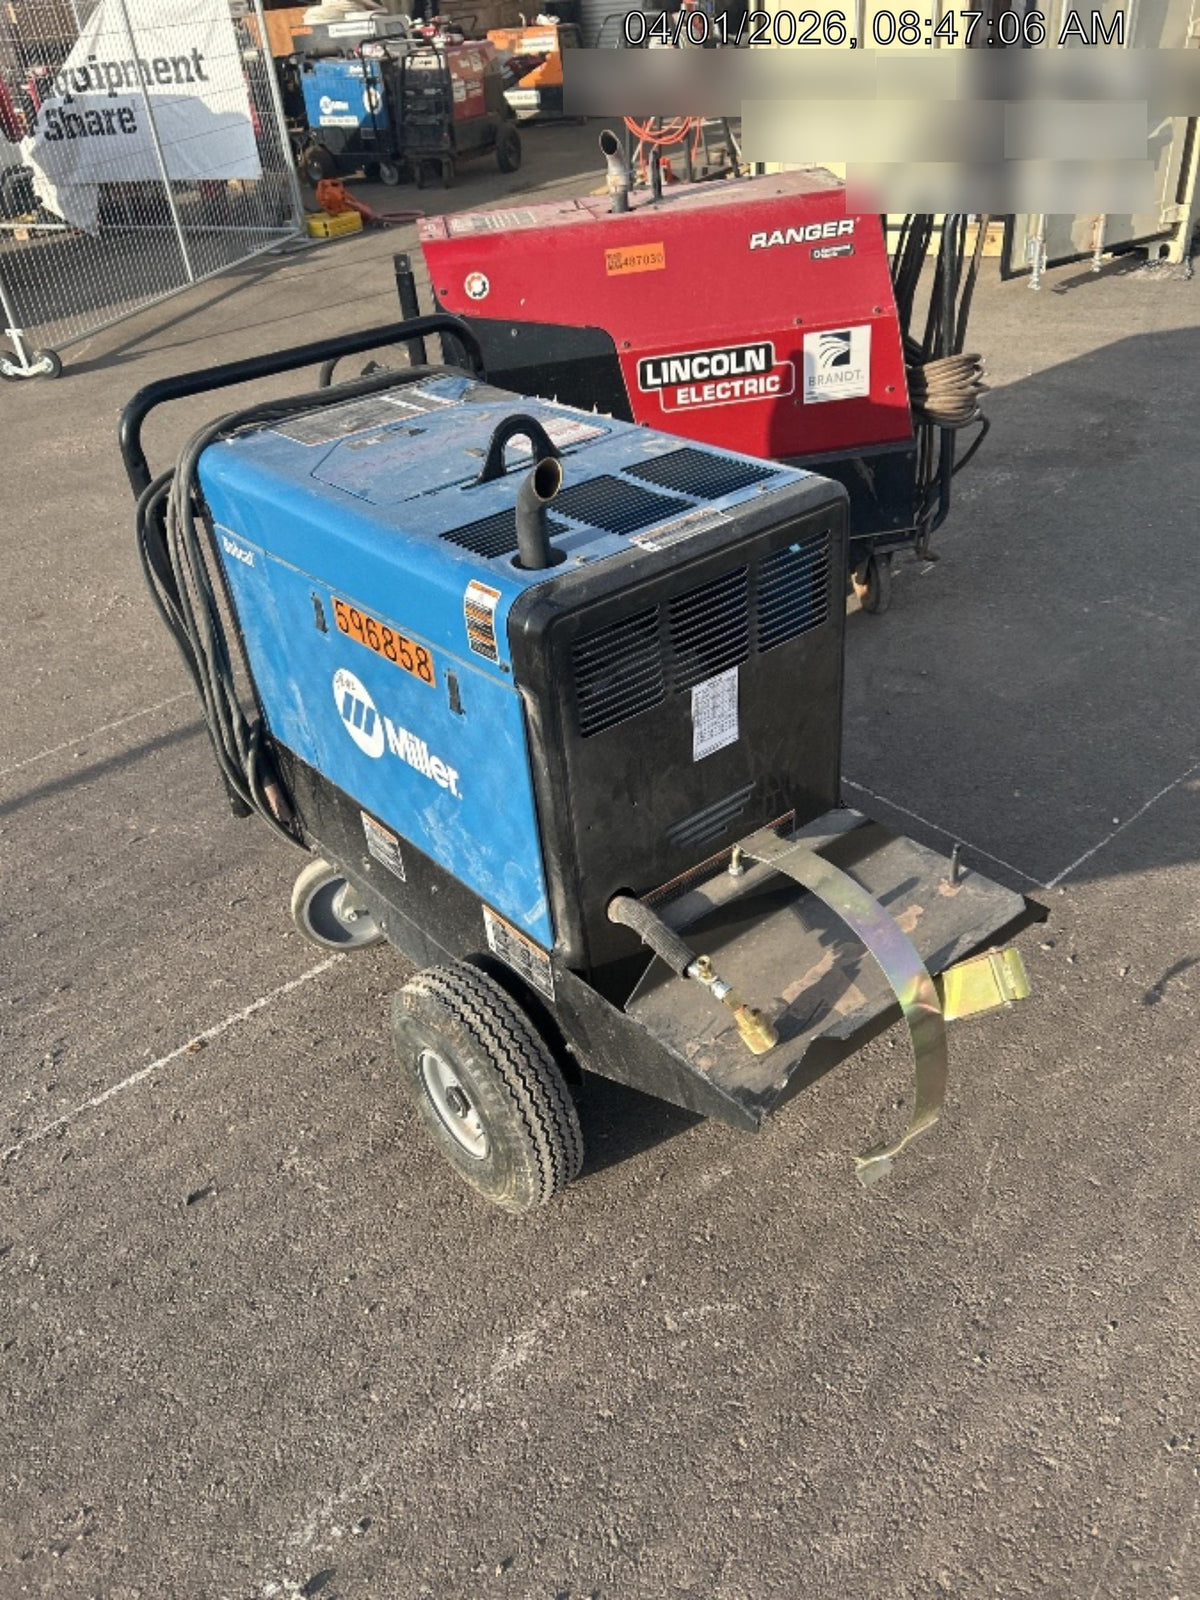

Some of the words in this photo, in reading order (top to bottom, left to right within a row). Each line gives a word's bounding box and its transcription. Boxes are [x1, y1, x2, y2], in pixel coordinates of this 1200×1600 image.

[44, 104, 137, 141] Share
[750, 219, 854, 250] RANGER
[646, 348, 766, 385] LINCOLN
[677, 376, 780, 405] ELECTRIC
[335, 601, 432, 683] 596858
[384, 716, 459, 798] Miller
